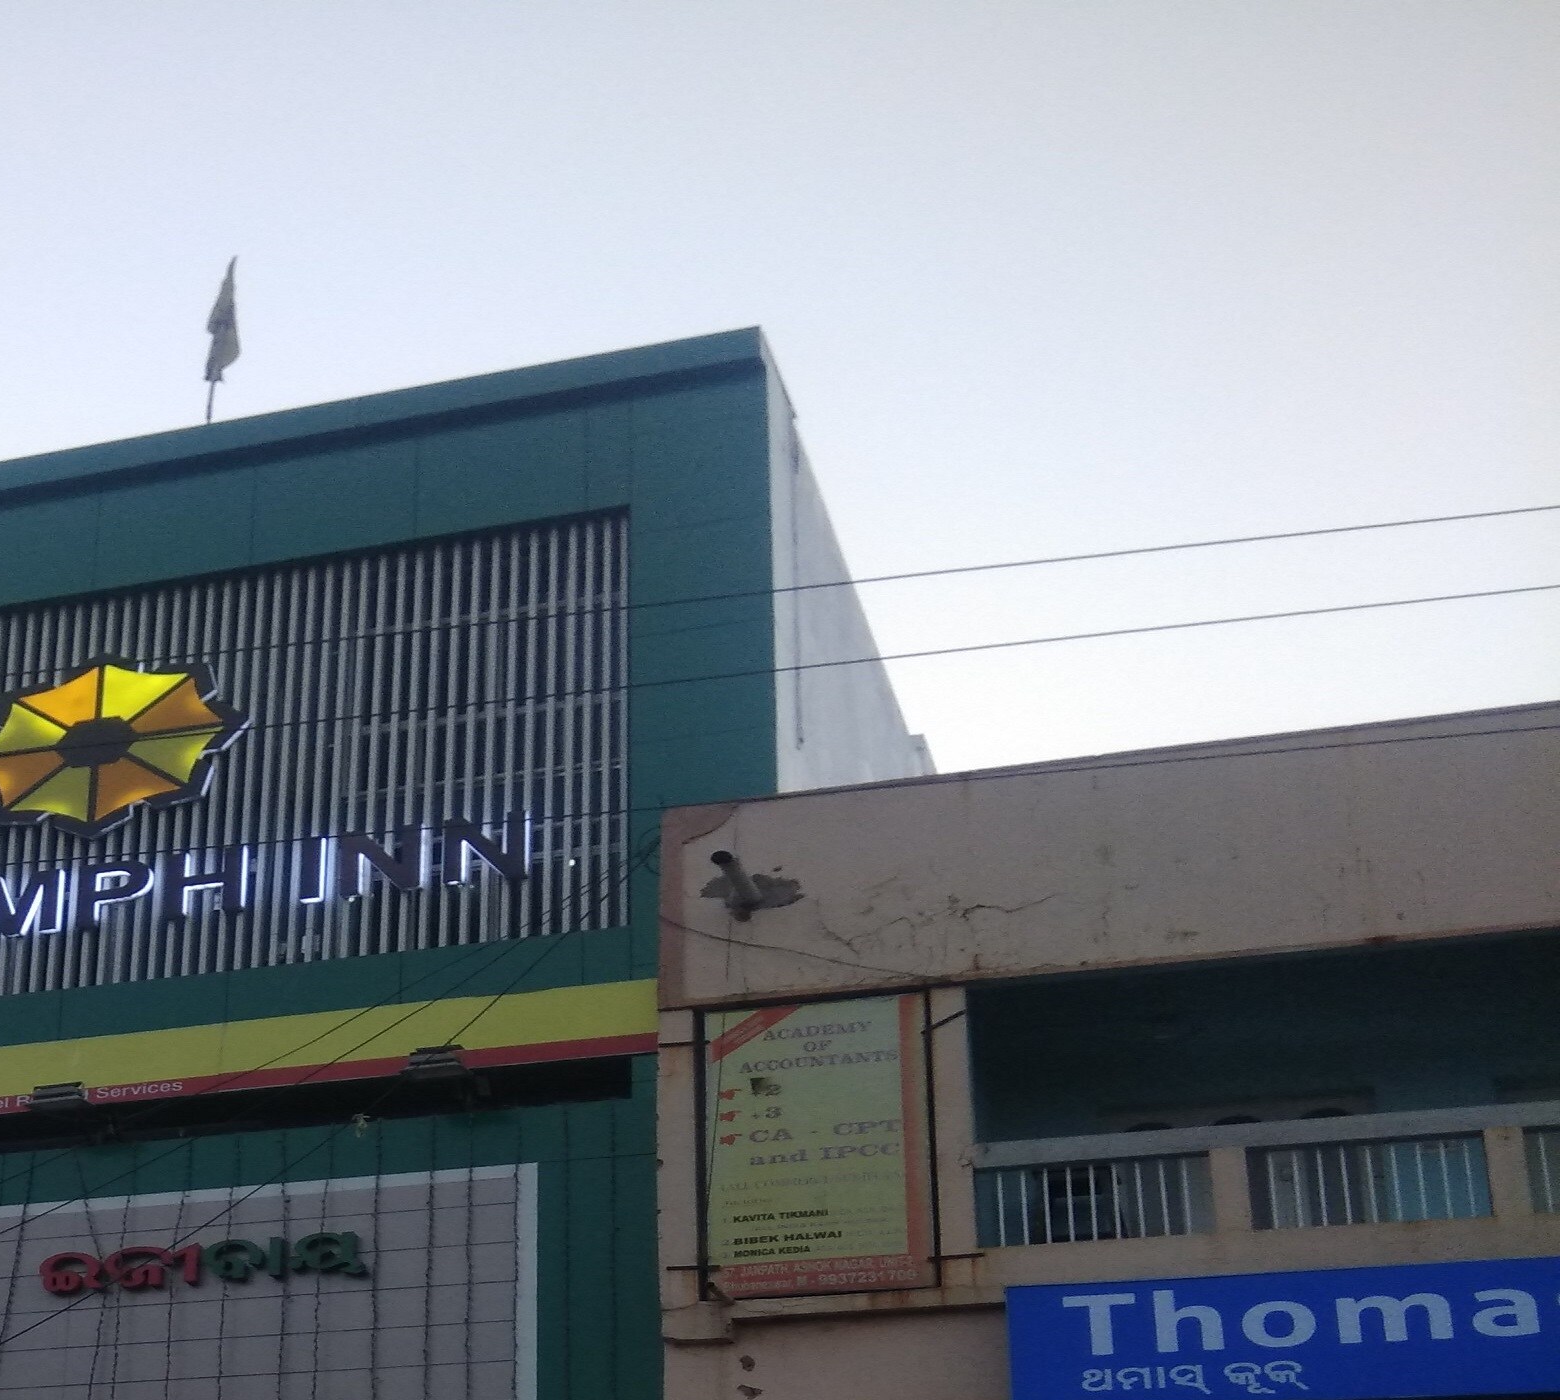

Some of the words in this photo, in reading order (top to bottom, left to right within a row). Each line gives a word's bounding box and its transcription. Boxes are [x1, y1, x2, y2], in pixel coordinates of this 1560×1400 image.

[300, 810, 532, 905] INN
[764, 1021, 872, 1041] ACADEMY
[803, 1040, 832, 1053] OF
[739, 1049, 898, 1074] ACCOUNTANTS
[97, 1080, 184, 1099] Services
[749, 1128, 793, 1143] CA
[750, 1149, 809, 1166] and
[733, 1212, 776, 1224] KAVITA
[732, 1234, 780, 1246] BIBEK
[1062, 1287, 1560, 1357] Thoma
